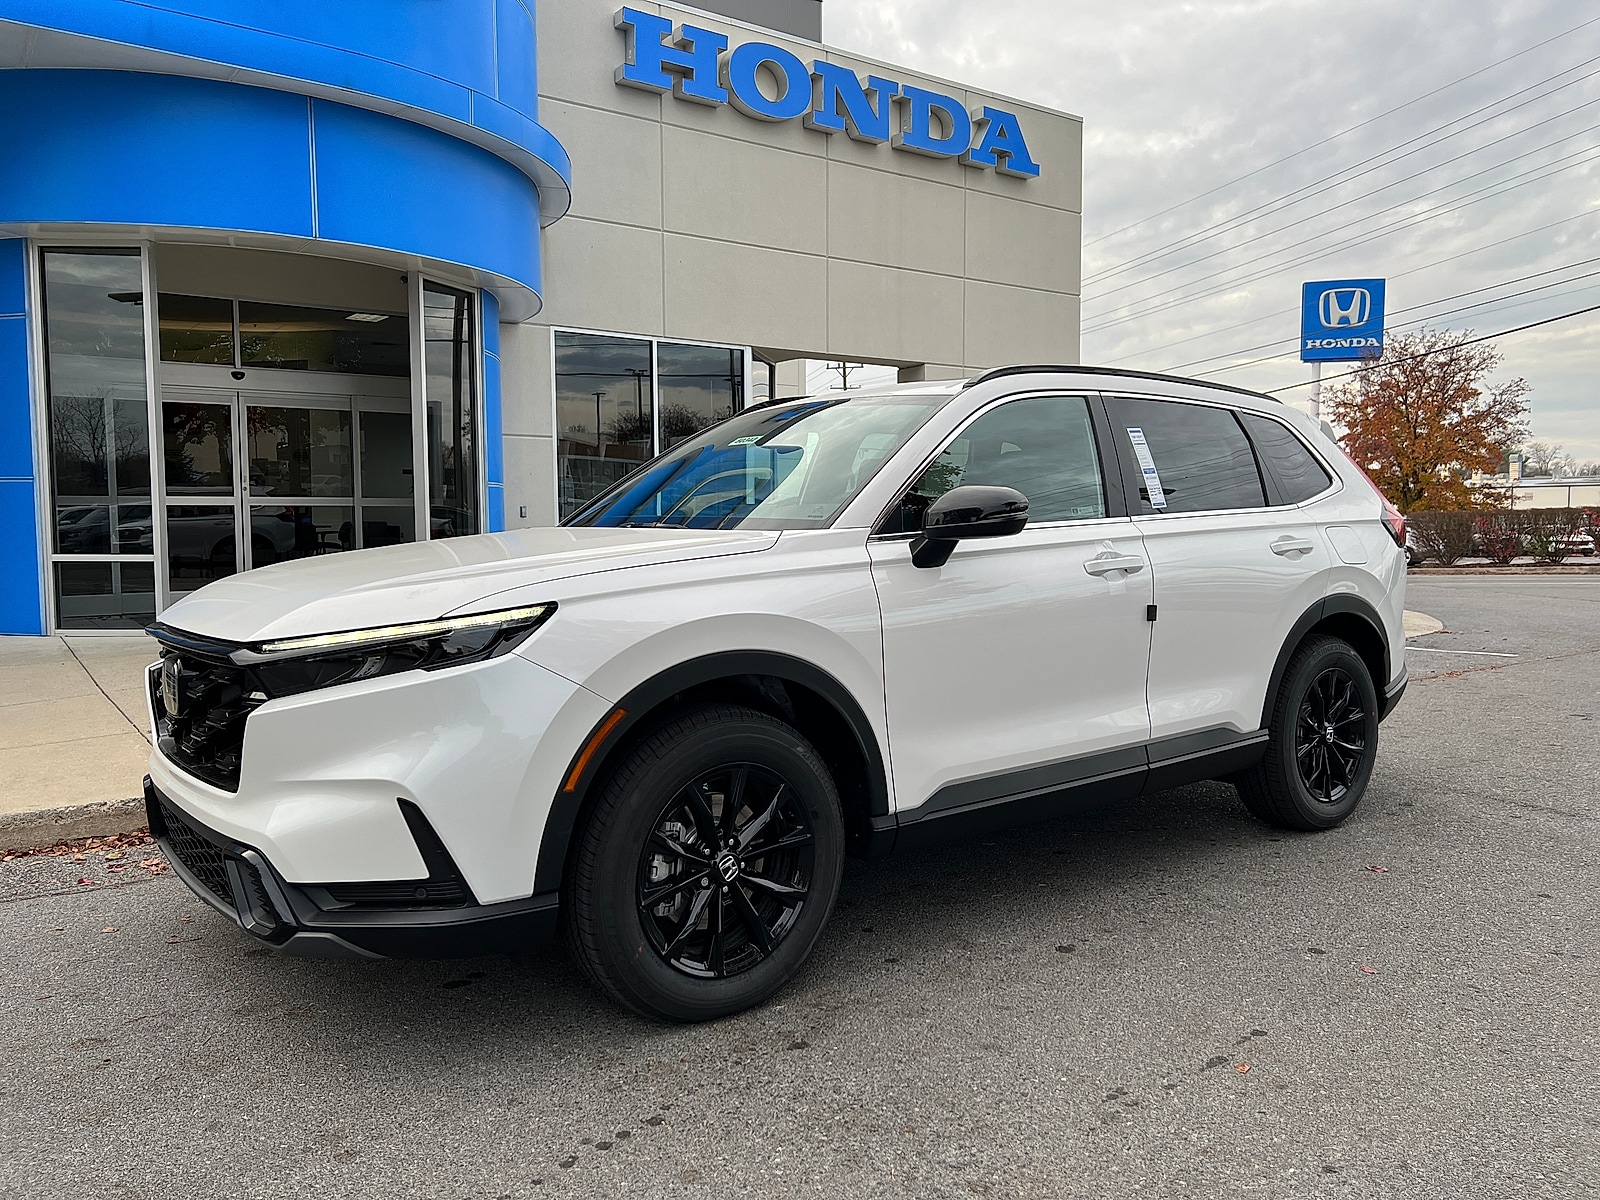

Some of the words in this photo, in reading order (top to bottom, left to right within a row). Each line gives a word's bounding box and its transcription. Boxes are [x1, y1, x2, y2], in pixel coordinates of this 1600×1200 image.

[616, 7, 1040, 179] HONDA
[1305, 337, 1380, 350] HONDA
[1312, 644, 1351, 661] BRIDGESTO
